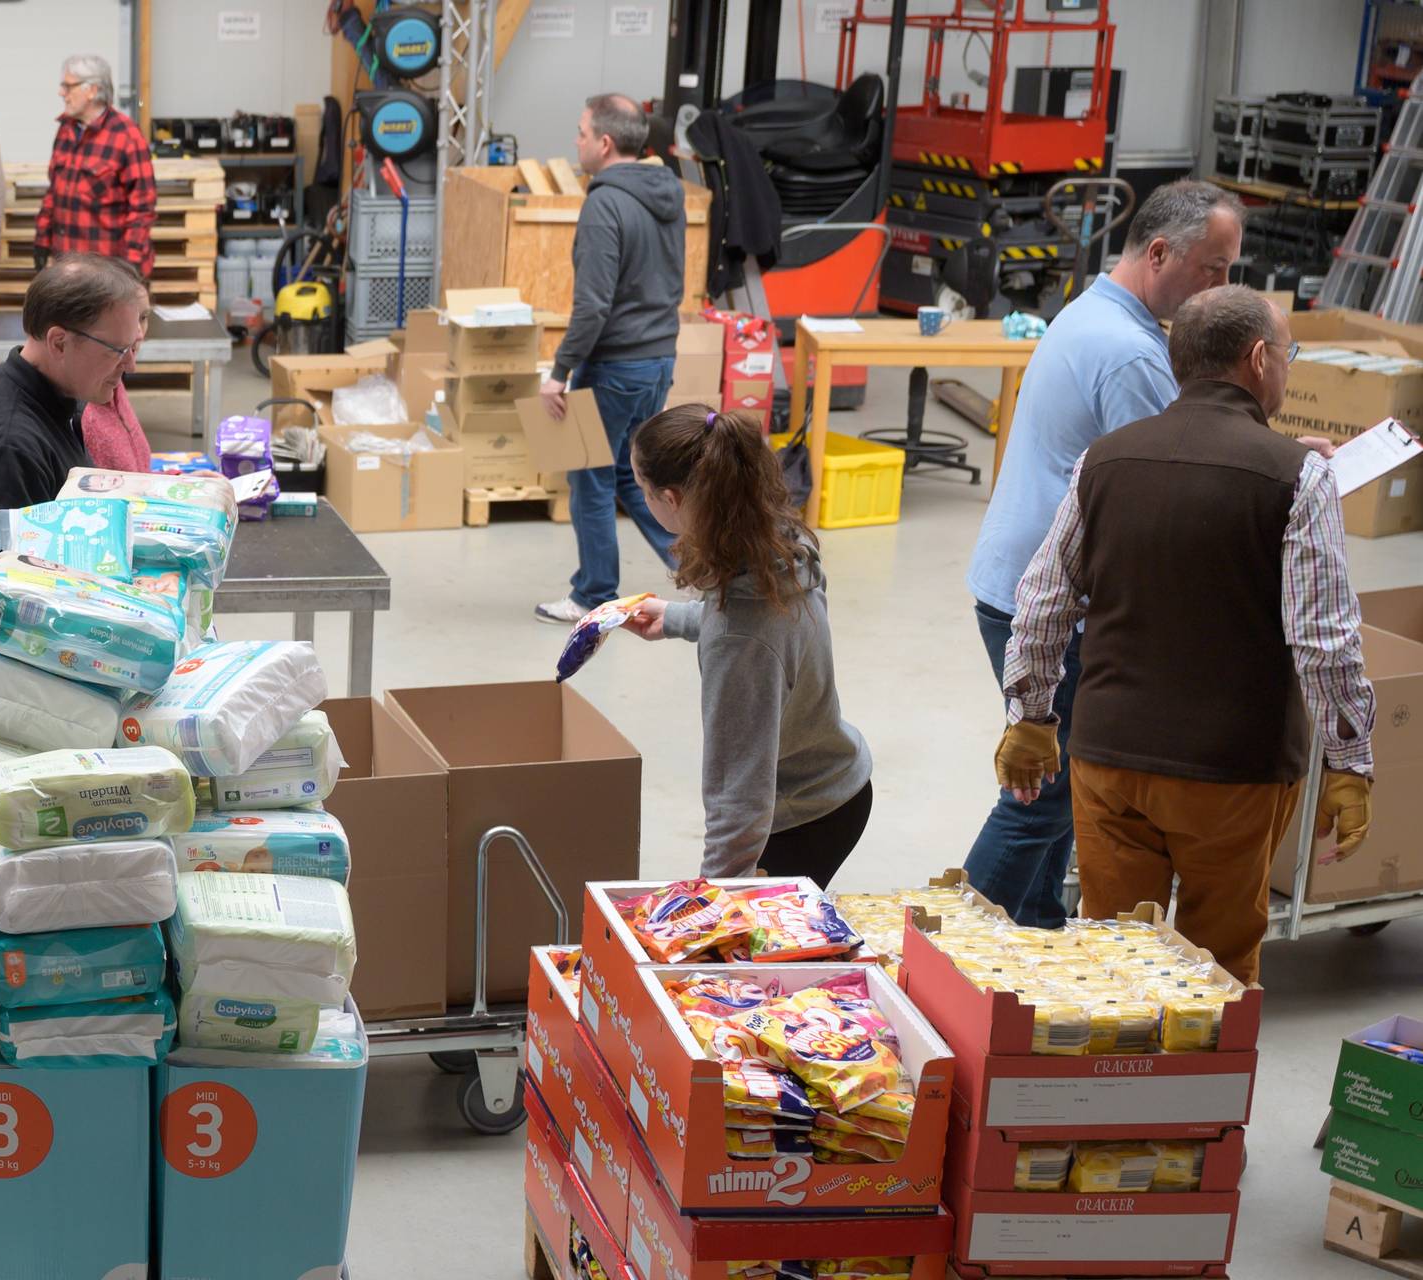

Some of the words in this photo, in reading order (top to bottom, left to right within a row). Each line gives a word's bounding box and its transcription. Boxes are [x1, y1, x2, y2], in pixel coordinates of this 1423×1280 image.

[28, 641, 38, 655] 3
[79, 784, 132, 800] Windeln
[44, 816, 62, 832] 2
[77, 815, 145, 835] babylove
[278, 856, 330, 868] PREMIUM
[218, 1002, 274, 1018] babylove
[283, 1032, 296, 1044] 2
[1093, 1059, 1154, 1073] CRACKER
[196, 1092, 218, 1102] MIDI
[186, 1102, 223, 1157] 3
[7, 1159, 19, 1171] kg
[188, 1159, 206, 1169] 5-9
[209, 1160, 221, 1171] kg
[708, 1155, 813, 1206] nimm2
[814, 1173, 852, 1197] Bonbon
[846, 1175, 873, 1196] Soft
[1075, 1198, 1136, 1211] CRACKER
[1345, 1215, 1363, 1241] A
